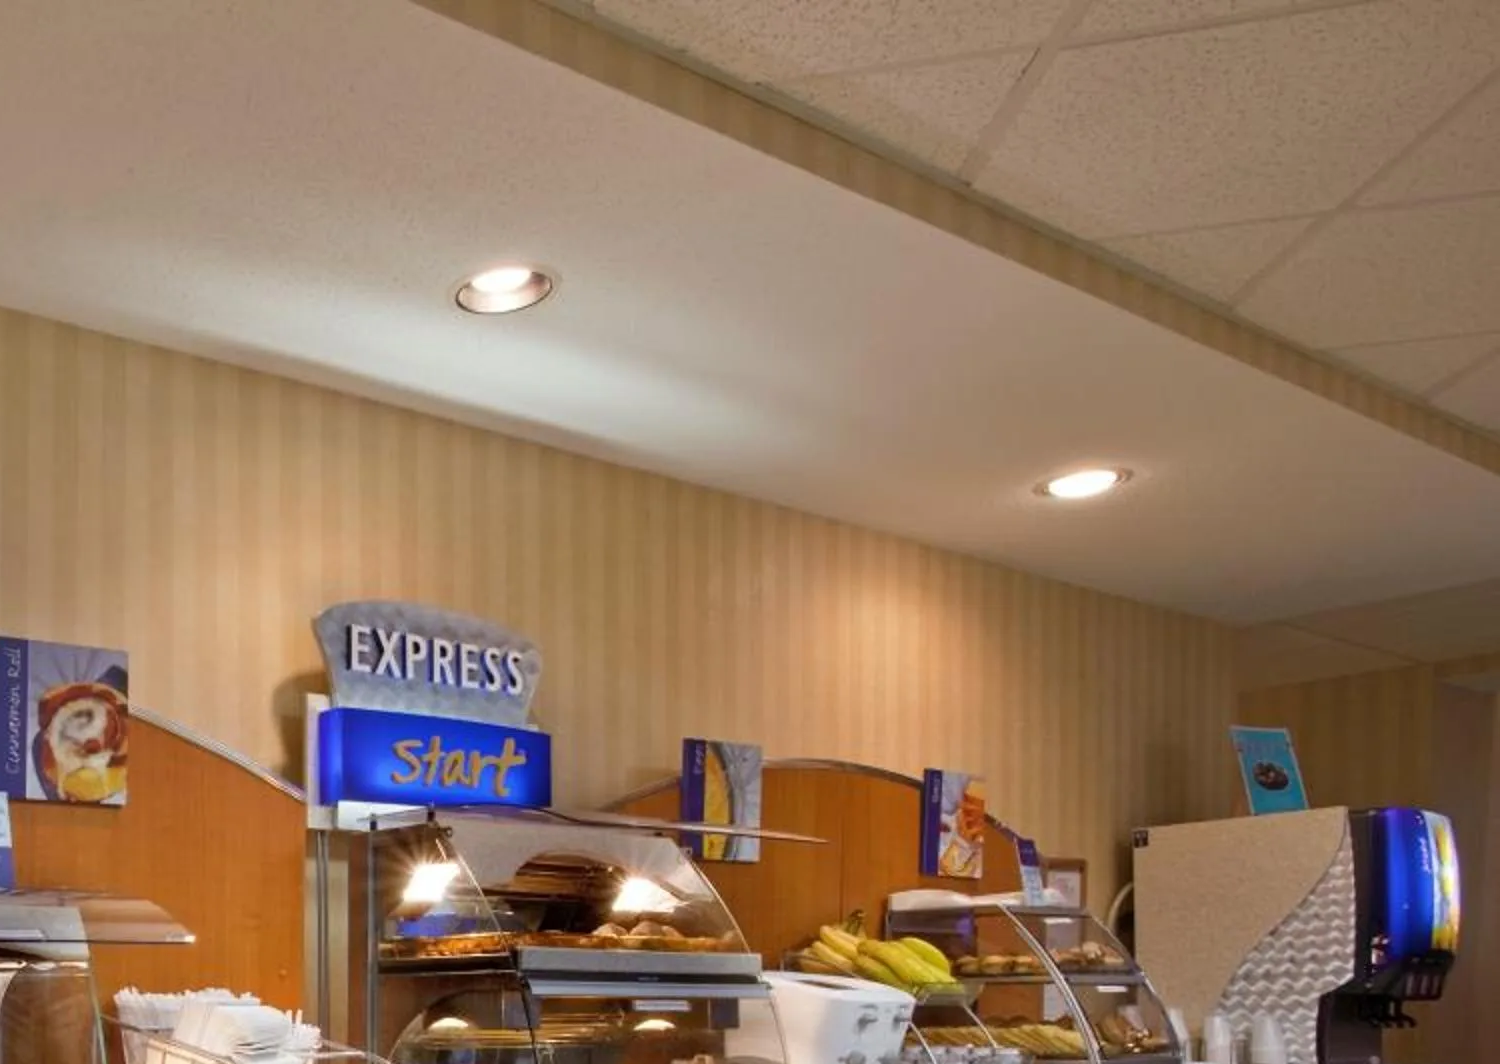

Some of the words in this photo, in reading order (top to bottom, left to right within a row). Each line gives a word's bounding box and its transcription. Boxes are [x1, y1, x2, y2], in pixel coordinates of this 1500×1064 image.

[2, 646, 21, 678] Roll
[346, 623, 524, 695] EXPRESS
[4, 683, 21, 774] Cinnamon
[390, 735, 527, 797] Start
